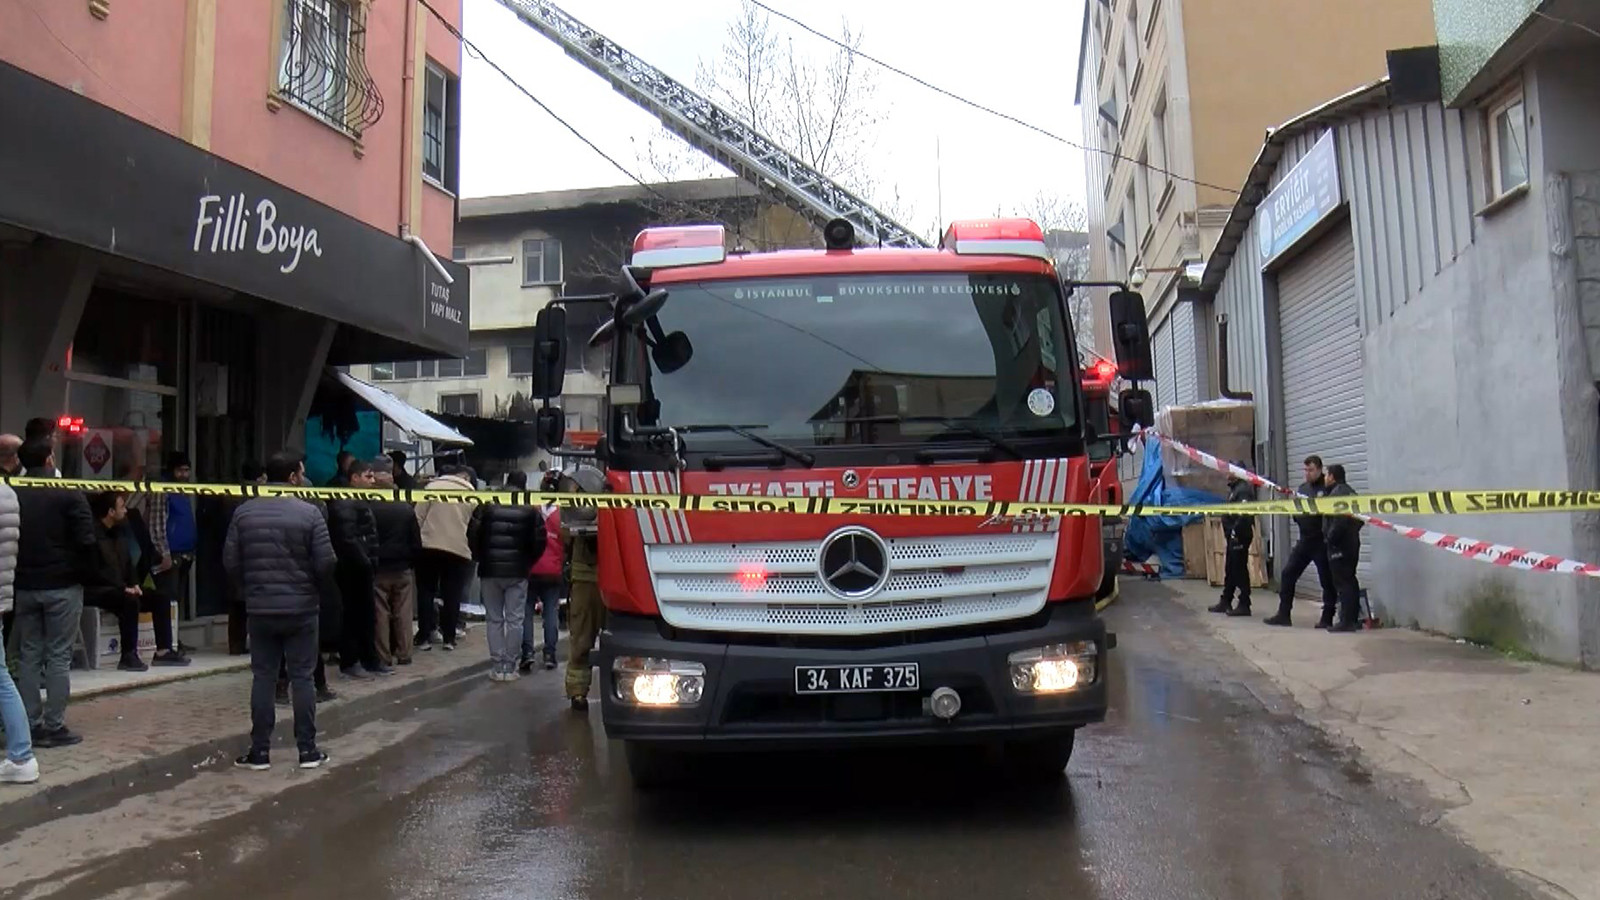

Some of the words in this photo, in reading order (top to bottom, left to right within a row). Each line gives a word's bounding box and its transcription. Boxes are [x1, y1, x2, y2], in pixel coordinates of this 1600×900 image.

[193, 193, 251, 253] Filli
[255, 198, 323, 274] Boya
[807, 669, 829, 690] 34
[840, 668, 873, 688] KAF
[883, 666, 916, 688] 375
